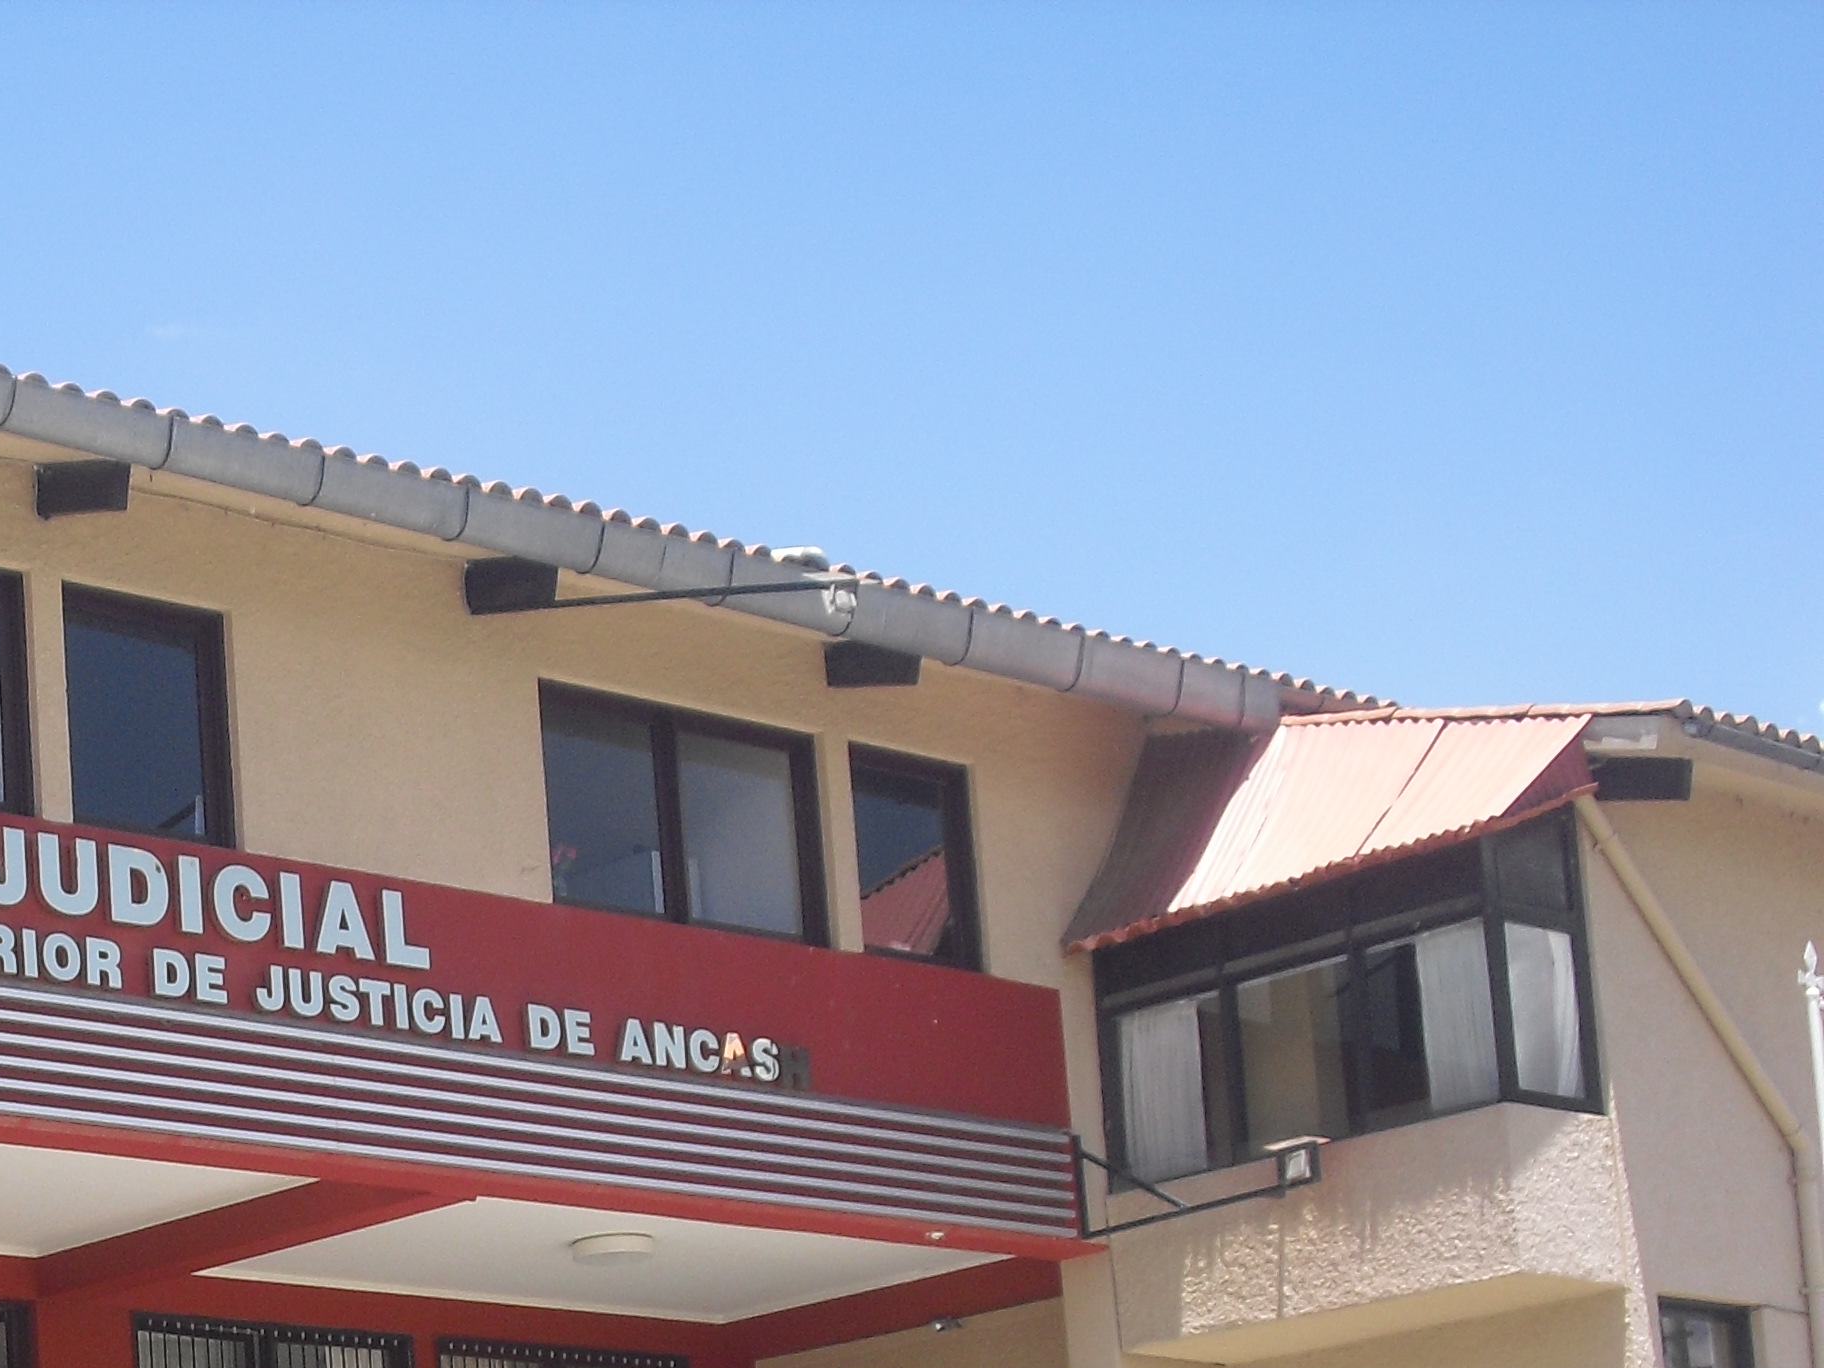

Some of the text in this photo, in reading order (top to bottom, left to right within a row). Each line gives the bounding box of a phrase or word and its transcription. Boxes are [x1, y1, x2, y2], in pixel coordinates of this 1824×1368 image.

[152, 948, 228, 1005] DE
[256, 964, 503, 1043] JUSTICIA
[528, 1003, 596, 1057] DE
